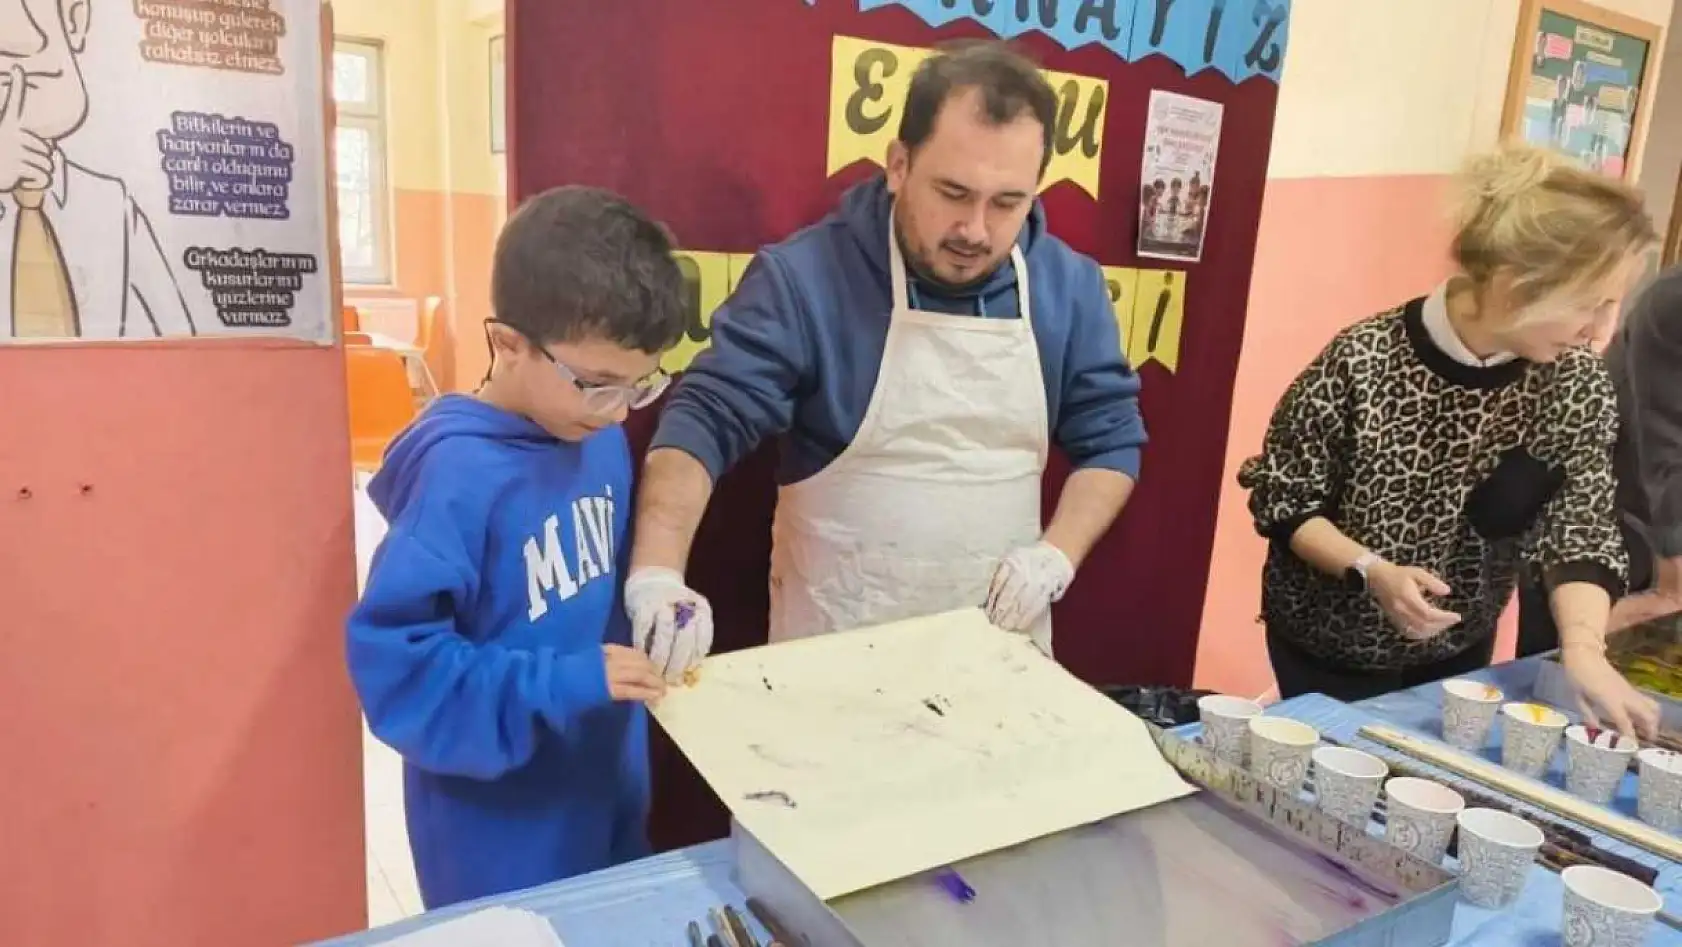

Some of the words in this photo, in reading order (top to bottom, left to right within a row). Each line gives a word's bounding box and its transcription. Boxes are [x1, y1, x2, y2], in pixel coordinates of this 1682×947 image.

[176, 115, 252, 136] Bitkilerin
[256, 127, 275, 139] ve
[268, 141, 290, 158] da
[233, 180, 284, 197] onlara
[175, 199, 219, 212] zarar
